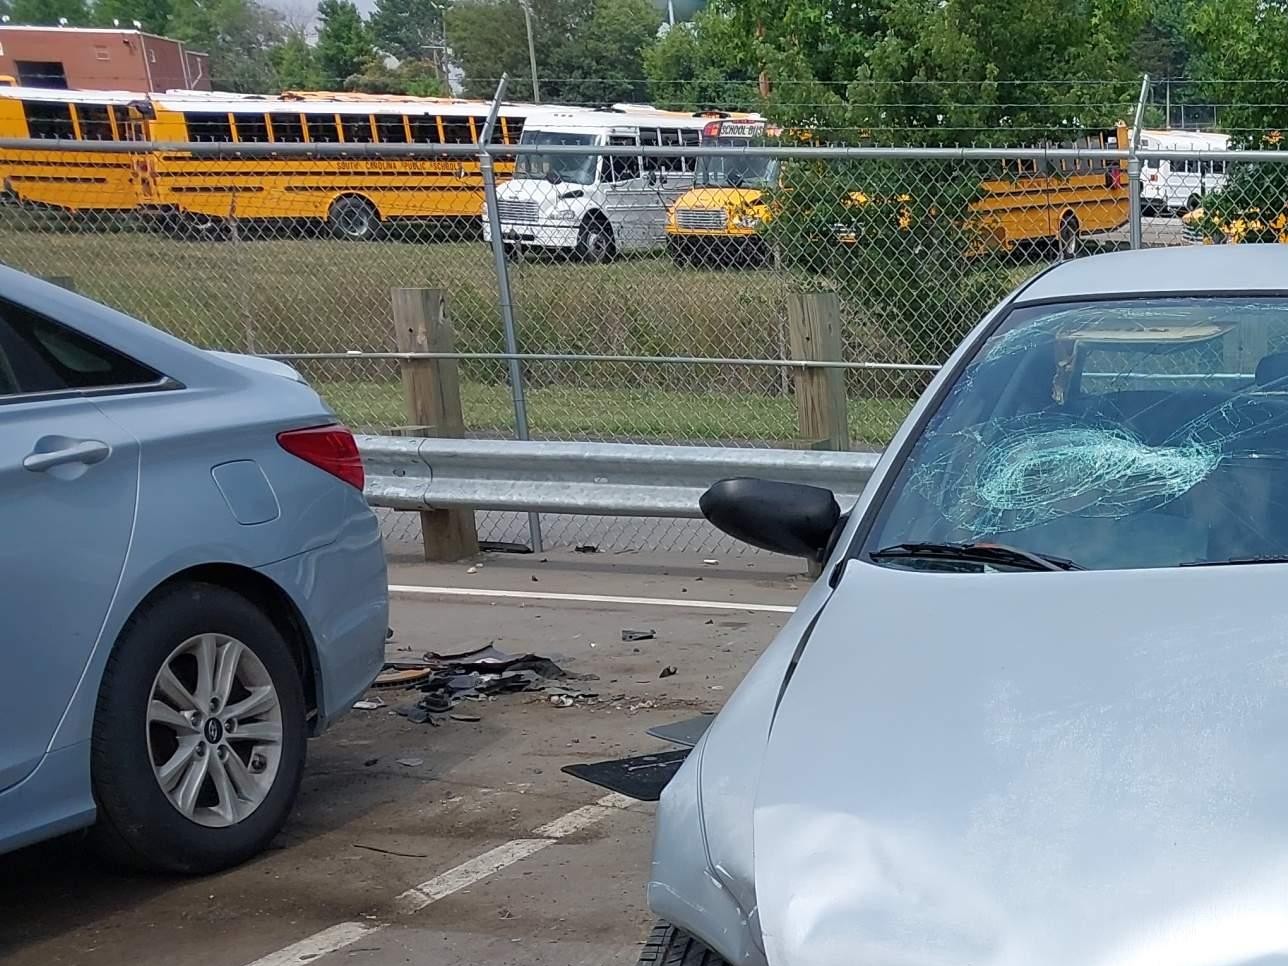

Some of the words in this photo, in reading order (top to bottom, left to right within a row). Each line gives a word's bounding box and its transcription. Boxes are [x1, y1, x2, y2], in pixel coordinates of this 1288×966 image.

[720, 124, 746, 136] SCHOOL
[366, 161, 397, 170] CAROLINA
[403, 161, 425, 170] PUBLIC
